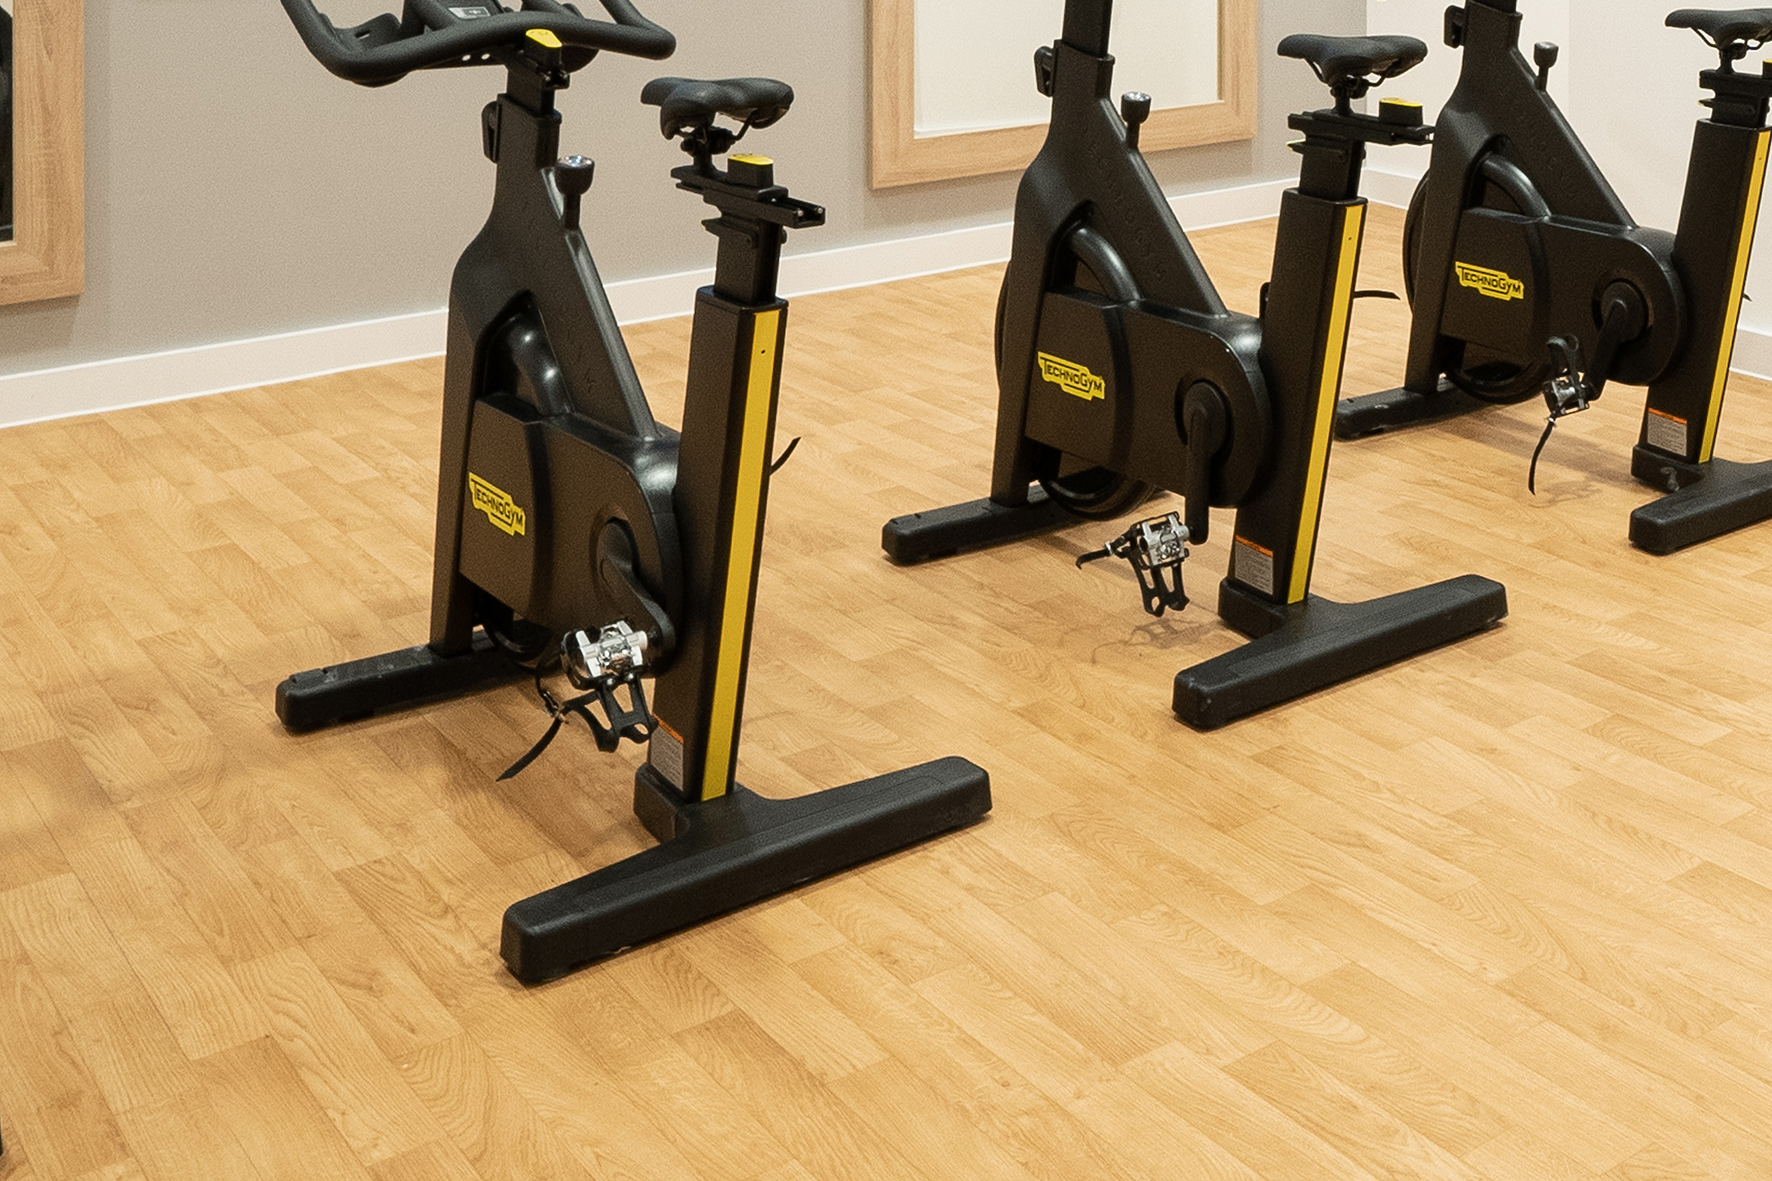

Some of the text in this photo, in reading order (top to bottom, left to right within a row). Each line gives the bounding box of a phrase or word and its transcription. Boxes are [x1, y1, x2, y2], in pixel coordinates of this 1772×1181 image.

[1457, 265, 1521, 295] TECHNOGYM
[1040, 356, 1102, 394] TECHNOGYM
[471, 479, 523, 527] TECHNOGYM
